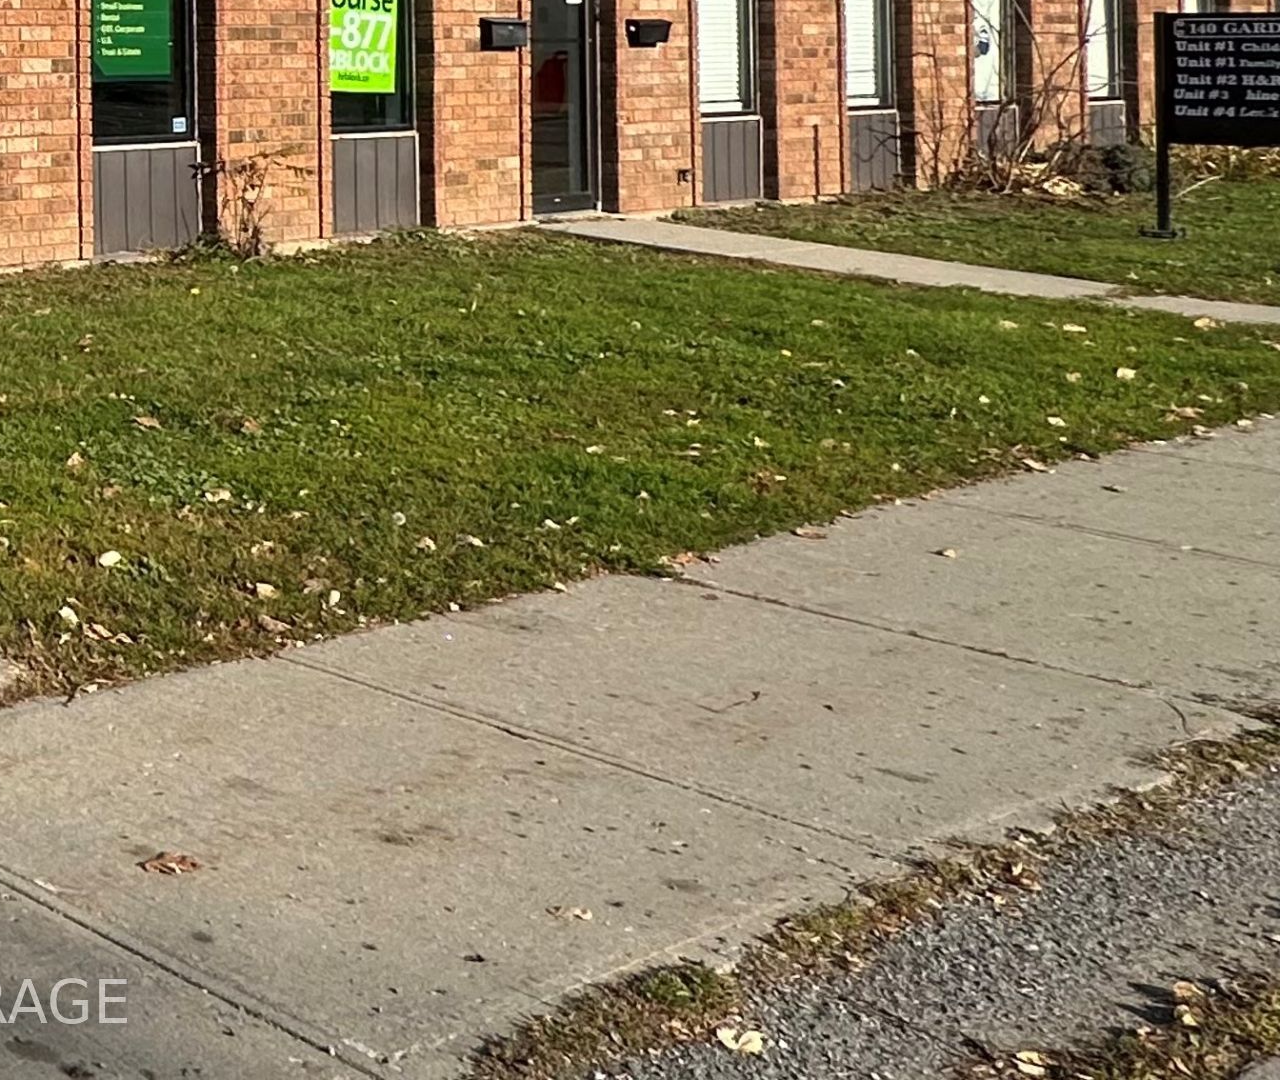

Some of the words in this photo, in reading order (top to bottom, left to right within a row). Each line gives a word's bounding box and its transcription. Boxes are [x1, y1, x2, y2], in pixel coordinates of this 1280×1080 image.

[1189, 23, 1217, 34] 140
[1223, 23, 1280, 34] GARD
[1175, 41, 1210, 51] Unit
[1214, 41, 1235, 51] #1
[1176, 57, 1211, 67] Unit
[1215, 57, 1235, 67] #1
[1176, 74, 1212, 85] Unit
[1216, 74, 1237, 85] #2
[1241, 74, 1280, 86] H&R
[1173, 88, 1205, 99] Unit
[1174, 105, 1209, 116] Unit
[1213, 106, 1235, 117] #4
